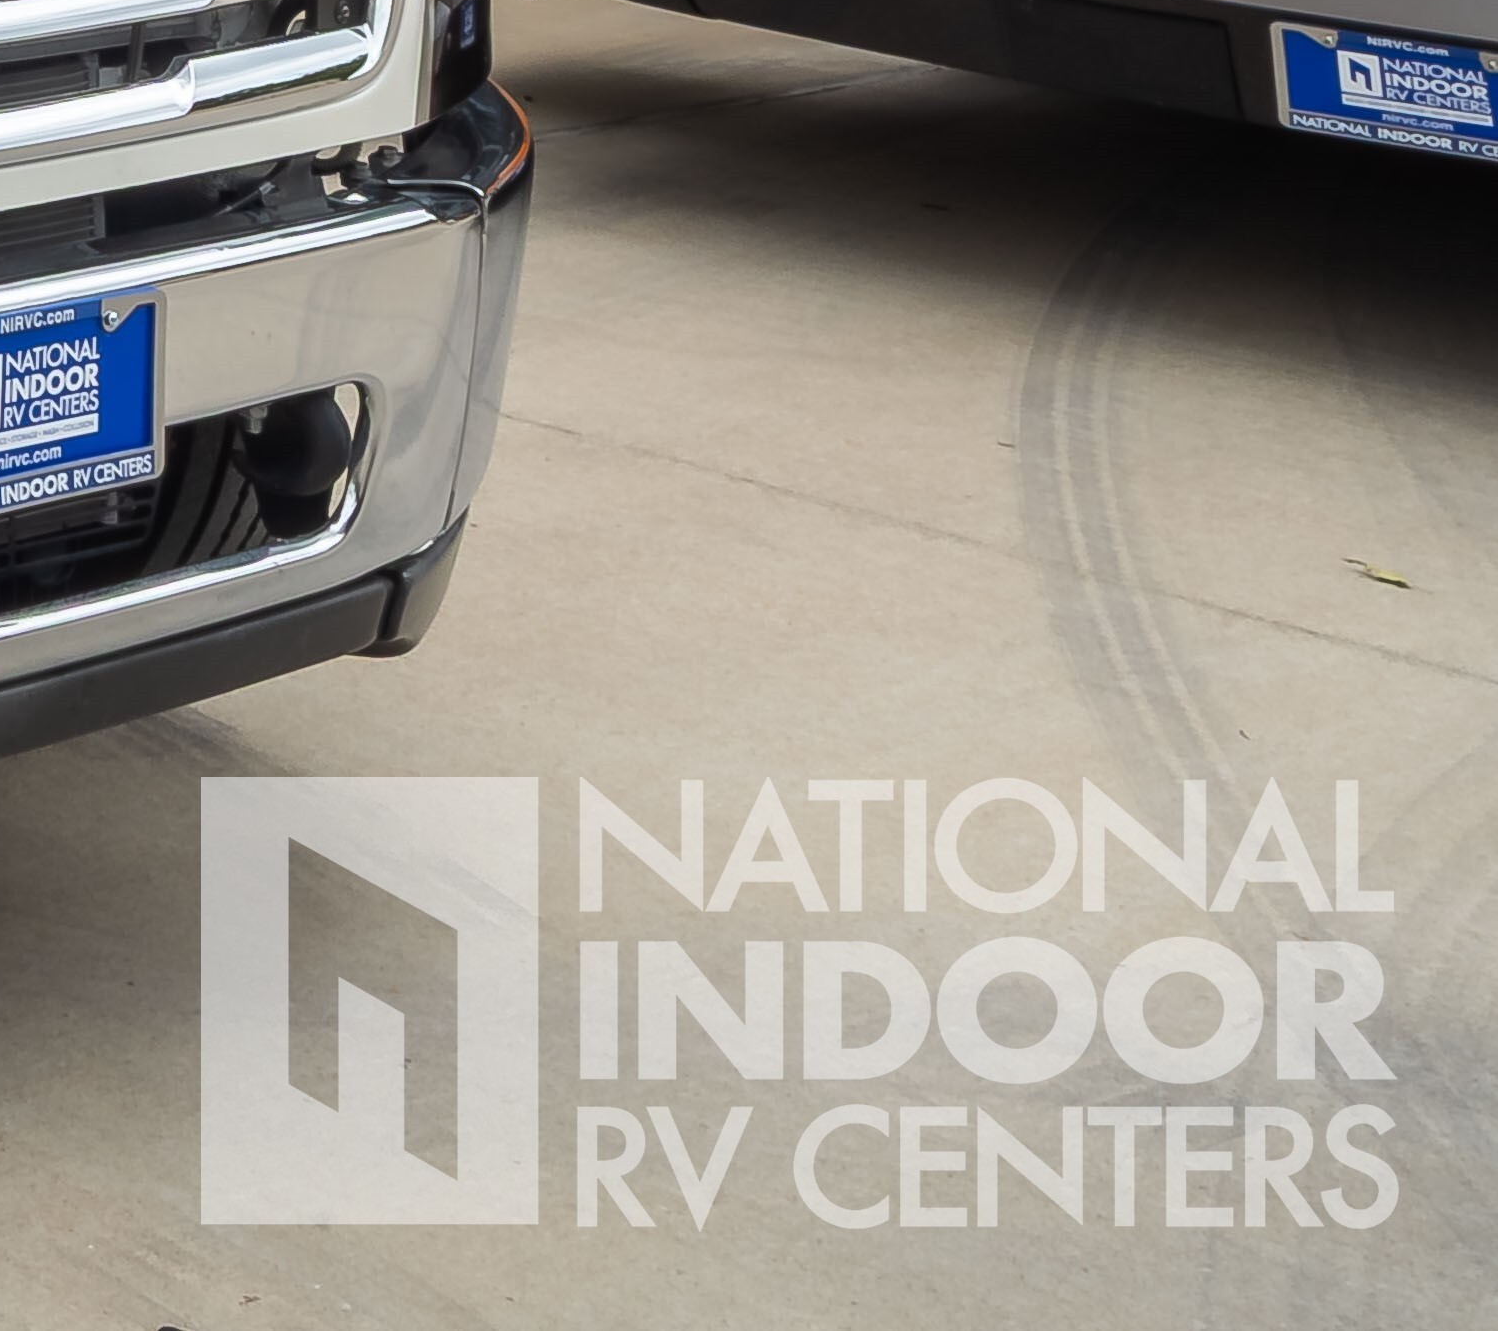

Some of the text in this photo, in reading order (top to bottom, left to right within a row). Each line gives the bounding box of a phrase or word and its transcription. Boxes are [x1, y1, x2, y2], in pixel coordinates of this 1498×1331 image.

[1367, 36, 1449, 57] NIRVC.com
[1383, 57, 1488, 86] NATIONAL
[1385, 72, 1488, 101] INDOOR
[1386, 88, 1409, 101] RV
[1412, 92, 1491, 115] CENTERS
[1293, 114, 1372, 138] NATIONAL
[1377, 128, 1453, 151] INDOOR
[1458, 140, 1479, 154] RV
[0, 308, 75, 335] NIRVC.com
[5, 336, 100, 375] NATIONAL
[5, 364, 99, 404] INDOOR
[3, 390, 99, 428] RV CENTERS
[0, 472, 69, 505] INDOOR
[73, 466, 92, 488] RV
[93, 455, 152, 481] CENTERS
